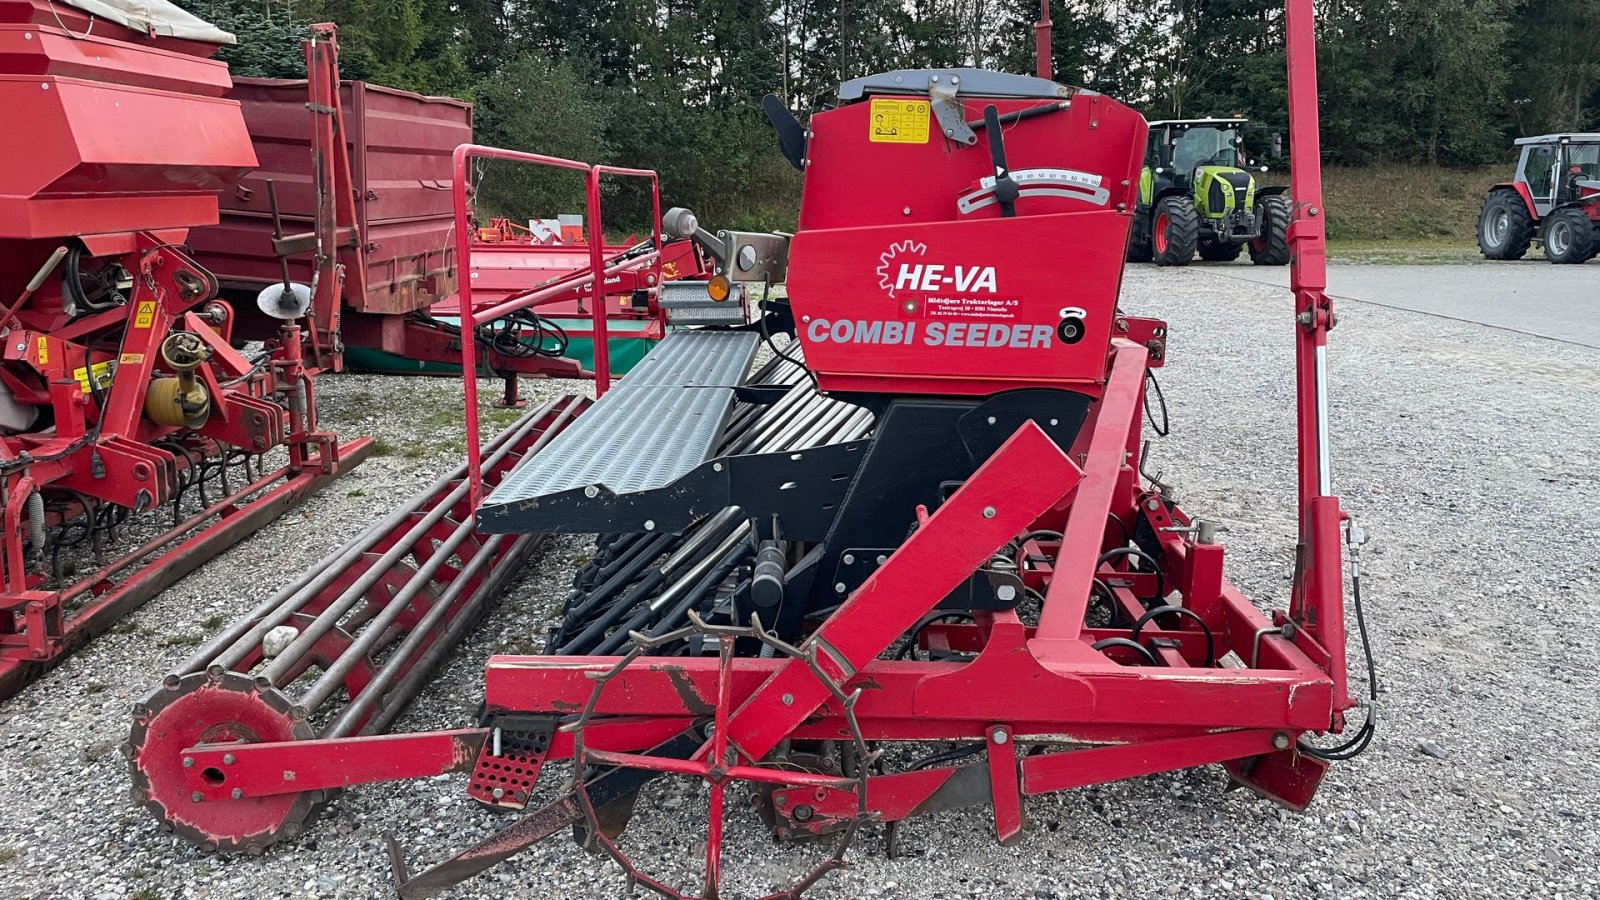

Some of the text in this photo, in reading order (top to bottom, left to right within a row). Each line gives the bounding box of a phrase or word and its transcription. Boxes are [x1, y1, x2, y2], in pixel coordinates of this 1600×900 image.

[895, 263, 998, 293] HE-VA
[807, 318, 1054, 349] COMBI SEEDER
